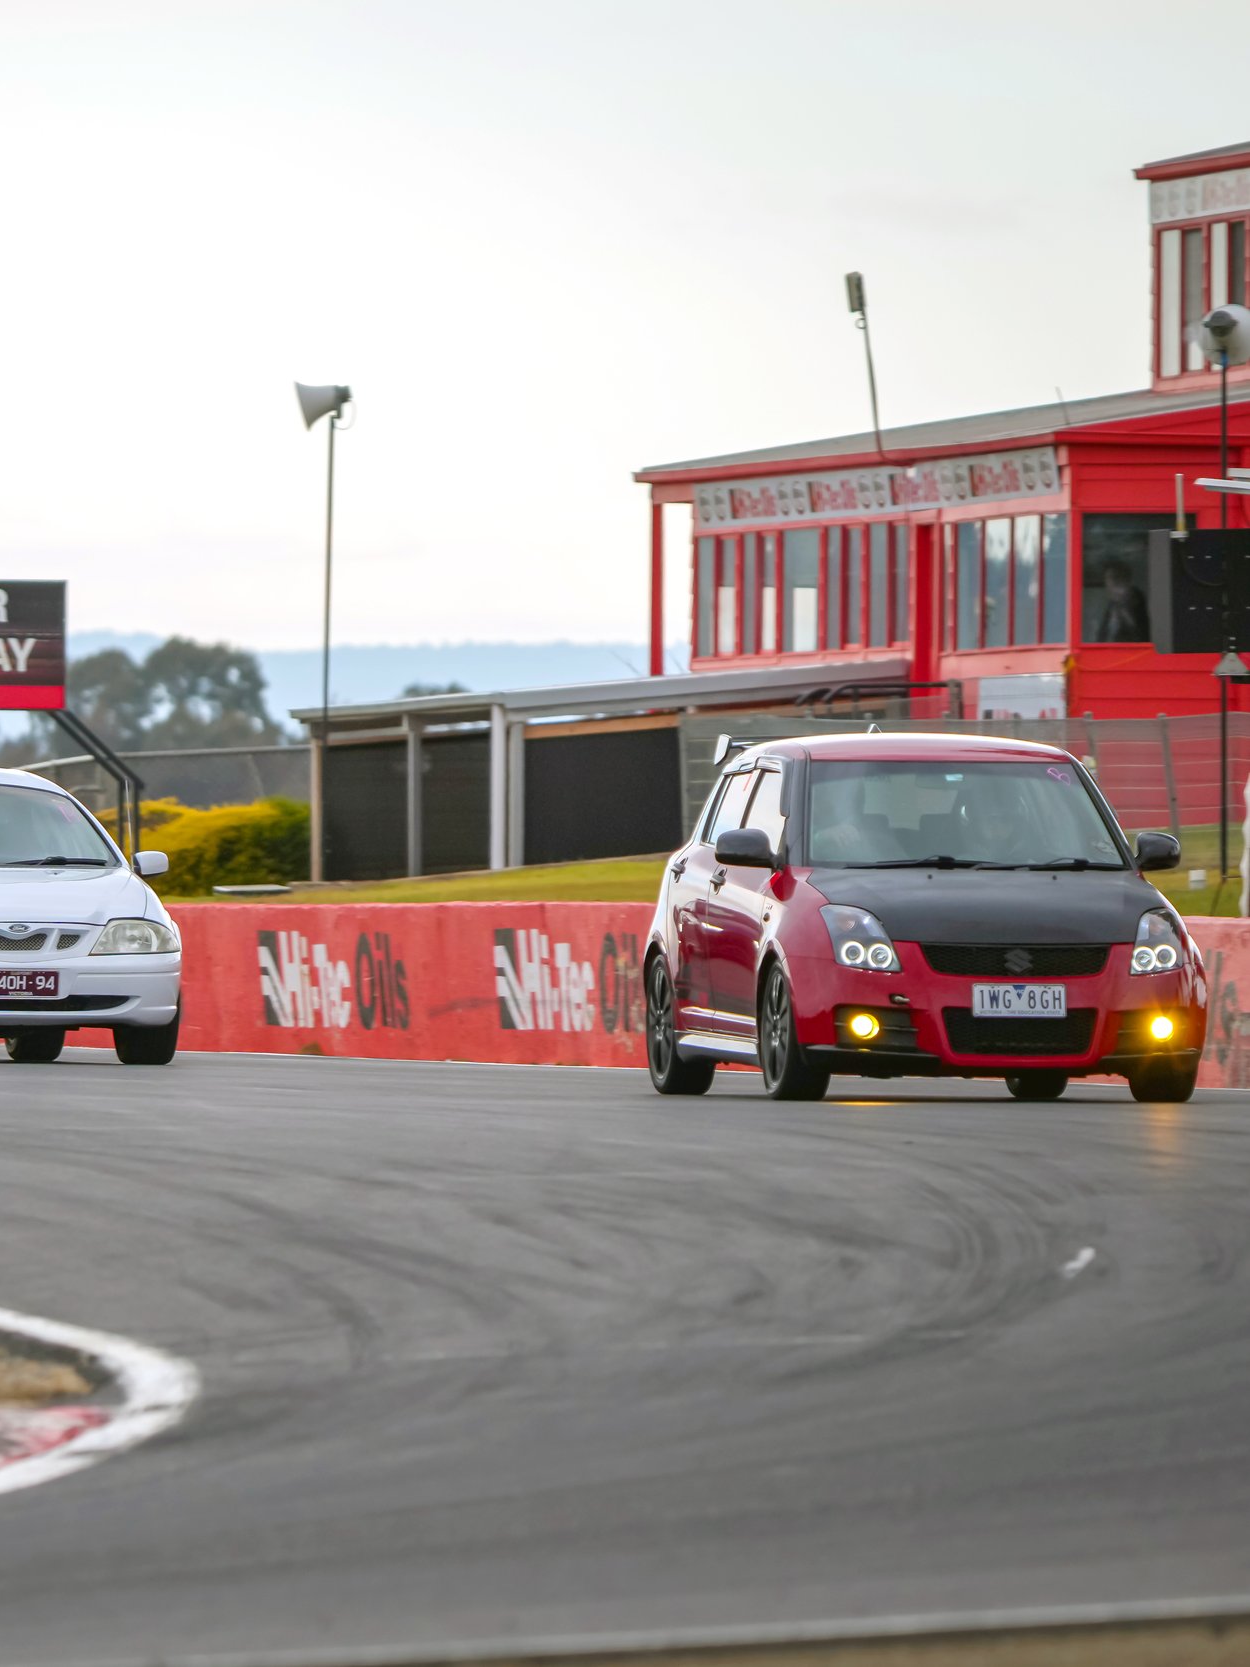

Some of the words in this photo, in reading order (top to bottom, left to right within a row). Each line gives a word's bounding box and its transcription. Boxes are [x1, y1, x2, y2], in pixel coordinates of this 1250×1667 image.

[274, 931, 351, 1028] Hi-Tec
[355, 932, 410, 1030] Oils
[514, 928, 595, 1032] Hi-Tec
[979, 989, 1012, 1009] 1WG
[1028, 990, 1062, 1009] 8GH
